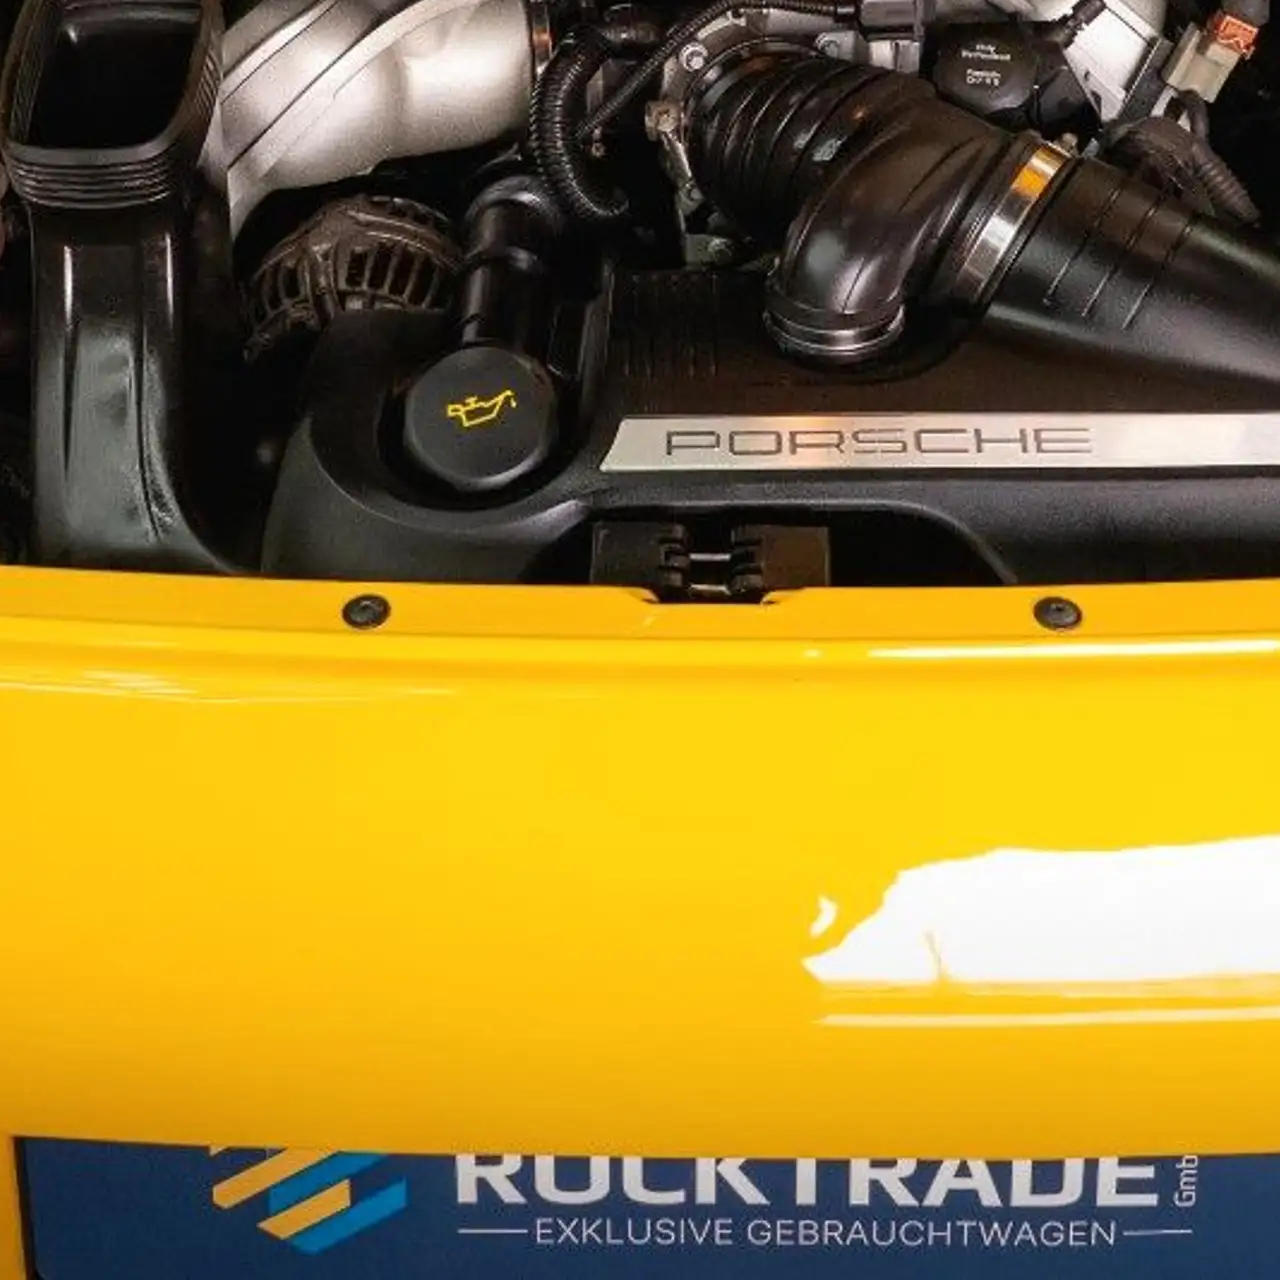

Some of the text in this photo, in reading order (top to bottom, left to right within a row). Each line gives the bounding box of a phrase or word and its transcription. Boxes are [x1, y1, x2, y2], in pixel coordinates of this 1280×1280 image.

[667, 428, 1092, 455] PORSCHE
[1174, 1155, 1198, 1207] Gmb
[536, 1218, 1117, 1247] EXKLUSIVE GEBRAUCHTWAGEN
